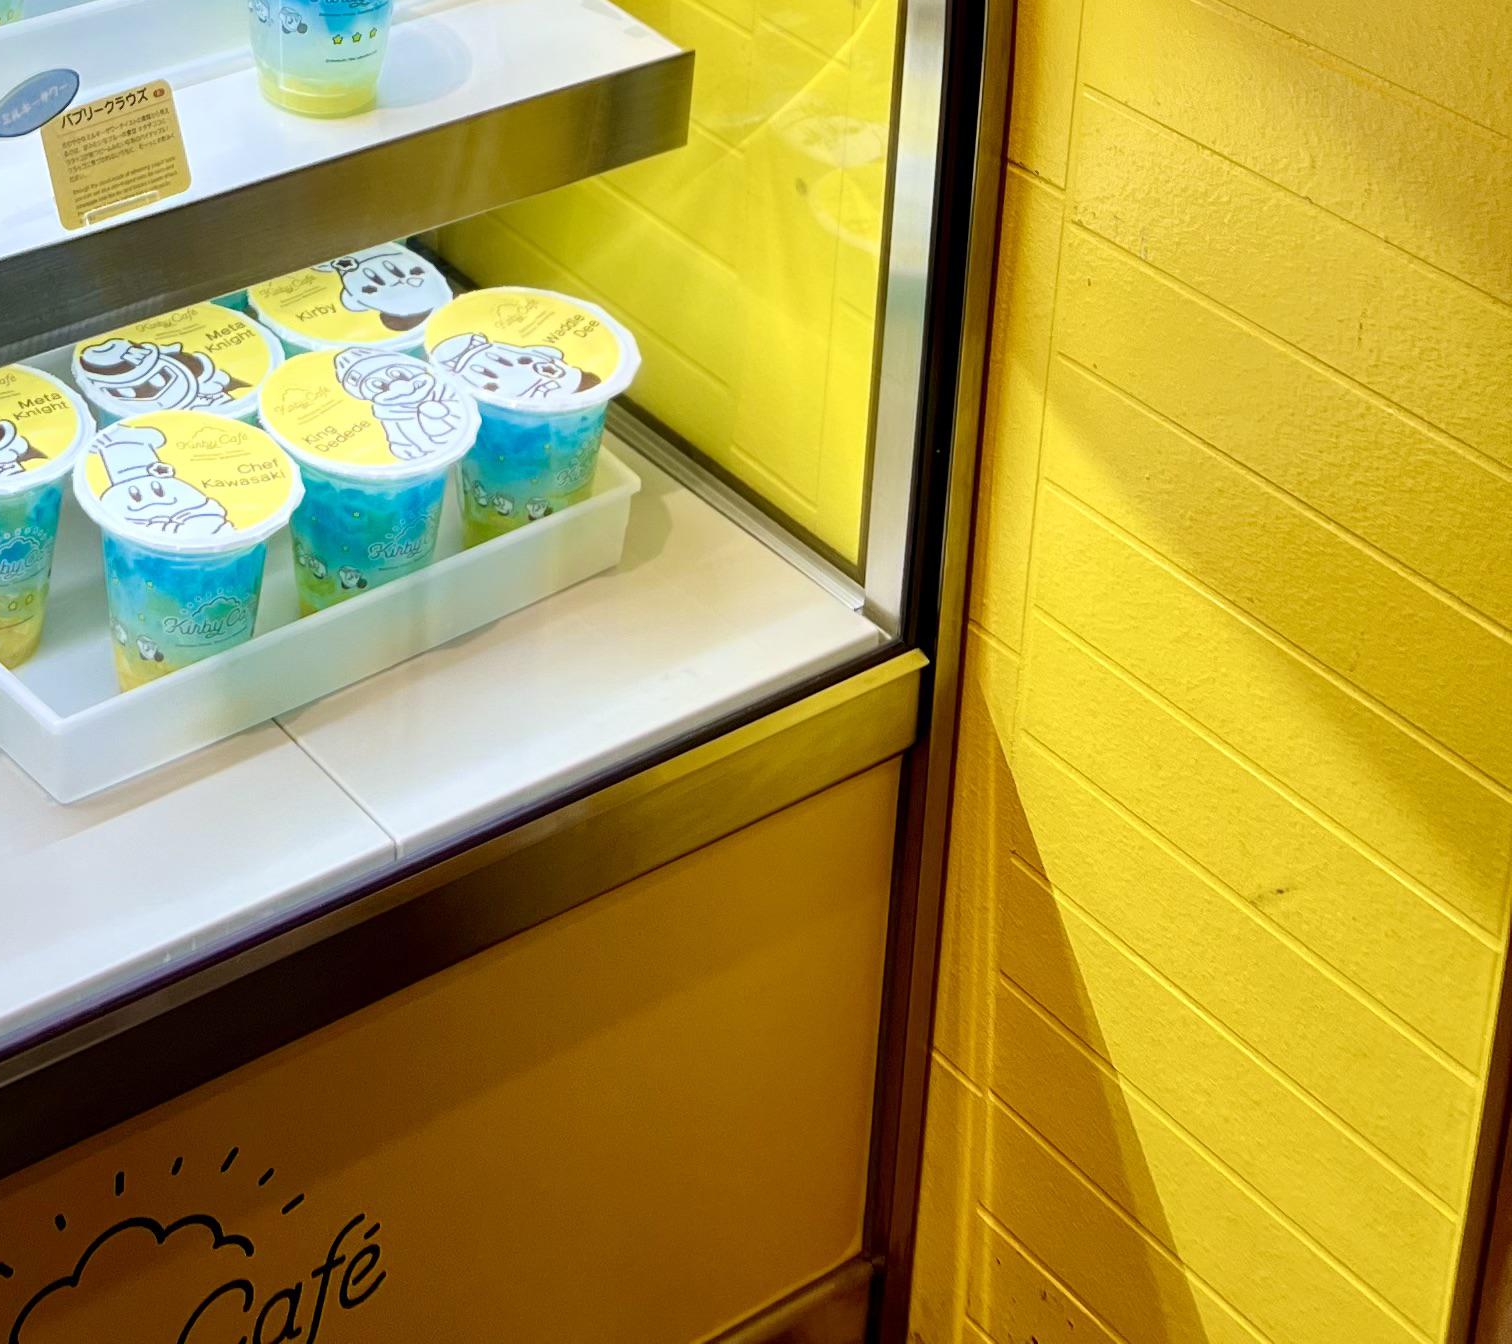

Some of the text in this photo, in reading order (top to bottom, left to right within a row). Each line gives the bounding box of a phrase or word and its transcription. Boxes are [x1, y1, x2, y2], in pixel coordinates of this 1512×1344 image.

[61, 87, 149, 129] バブリークラウズ
[205, 321, 246, 341] Meta
[205, 329, 257, 353] Knight
[12, 400, 70, 421] Knight
[17, 392, 62, 410] Meta
[236, 458, 279, 474] Chef
[201, 469, 287, 489] Kawasaki
[177, 1213, 387, 1344] Café
